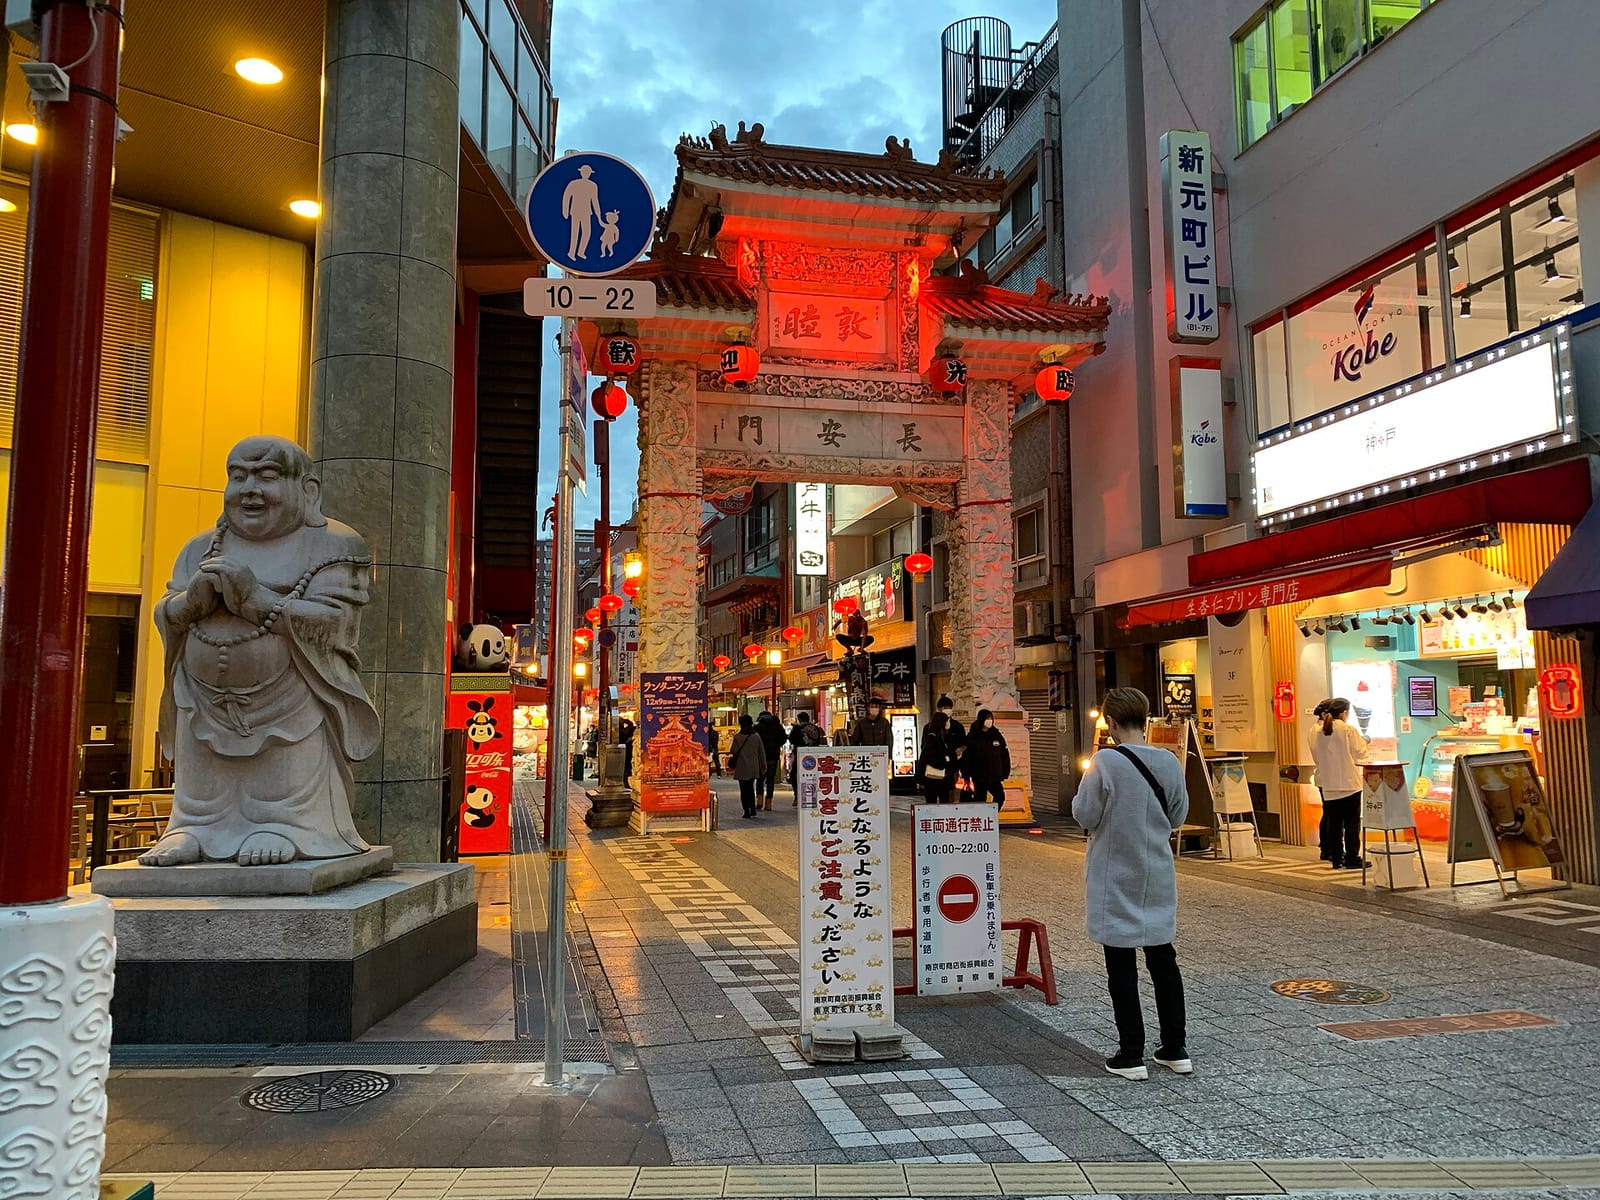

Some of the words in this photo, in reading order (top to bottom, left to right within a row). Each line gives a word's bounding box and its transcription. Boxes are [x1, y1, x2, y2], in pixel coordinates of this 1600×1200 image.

[1178, 143, 1213, 322] 新元町ビル
[1321, 329, 1356, 351] OCEAN
[1364, 308, 1402, 331] TOKYO
[608, 339, 636, 366] 歓
[1331, 329, 1398, 383] Kobe
[944, 359, 969, 387] 光
[737, 414, 923, 453] 長安門
[1191, 434, 1218, 447] Kobe
[1185, 579, 1300, 618] 生杏仁プリン専門店
[643, 680, 705, 693] ランターンフェア
[849, 755, 873, 919] 迷惑となるような
[919, 817, 995, 834] 車両通行禁止
[925, 842, 990, 855] 10:00~22:00
[817, 755, 843, 984] 客引きにご注意ください
[921, 865, 933, 956] 歩行者専用道路
[924, 972, 996, 986] 生田警察署
